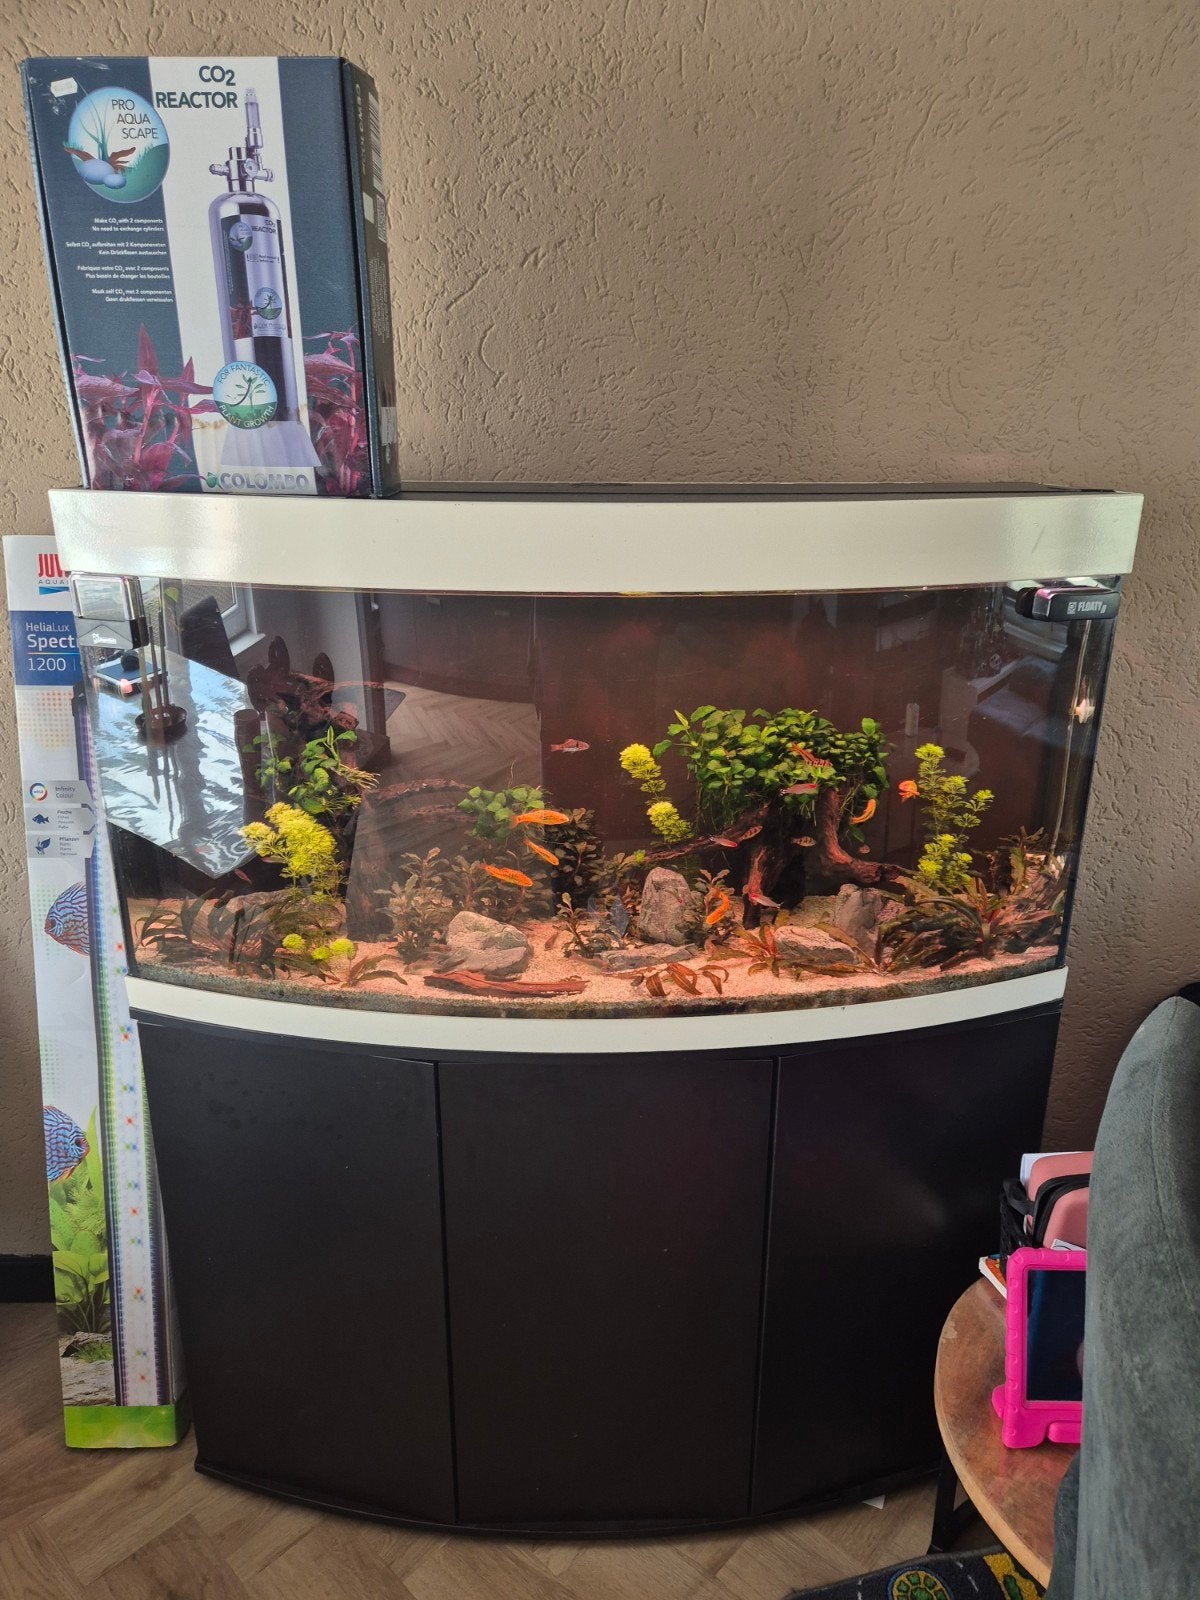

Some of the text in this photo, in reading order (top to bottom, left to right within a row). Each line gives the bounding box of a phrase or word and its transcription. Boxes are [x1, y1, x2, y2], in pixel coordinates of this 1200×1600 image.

[199, 65, 236, 86] CO2
[111, 99, 135, 111] PRO
[155, 91, 238, 109] REACTOR
[116, 113, 151, 125] AQUA
[122, 127, 159, 140] SCAPE
[218, 364, 272, 387] FOR FANTASTIC
[219, 404, 275, 428] PLANT GROWTH
[220, 472, 309, 490] COLOMBO
[1077, 600, 1104, 612] FLOATY
[25, 622, 70, 632] HeliaLux
[28, 657, 67, 672] 1200
